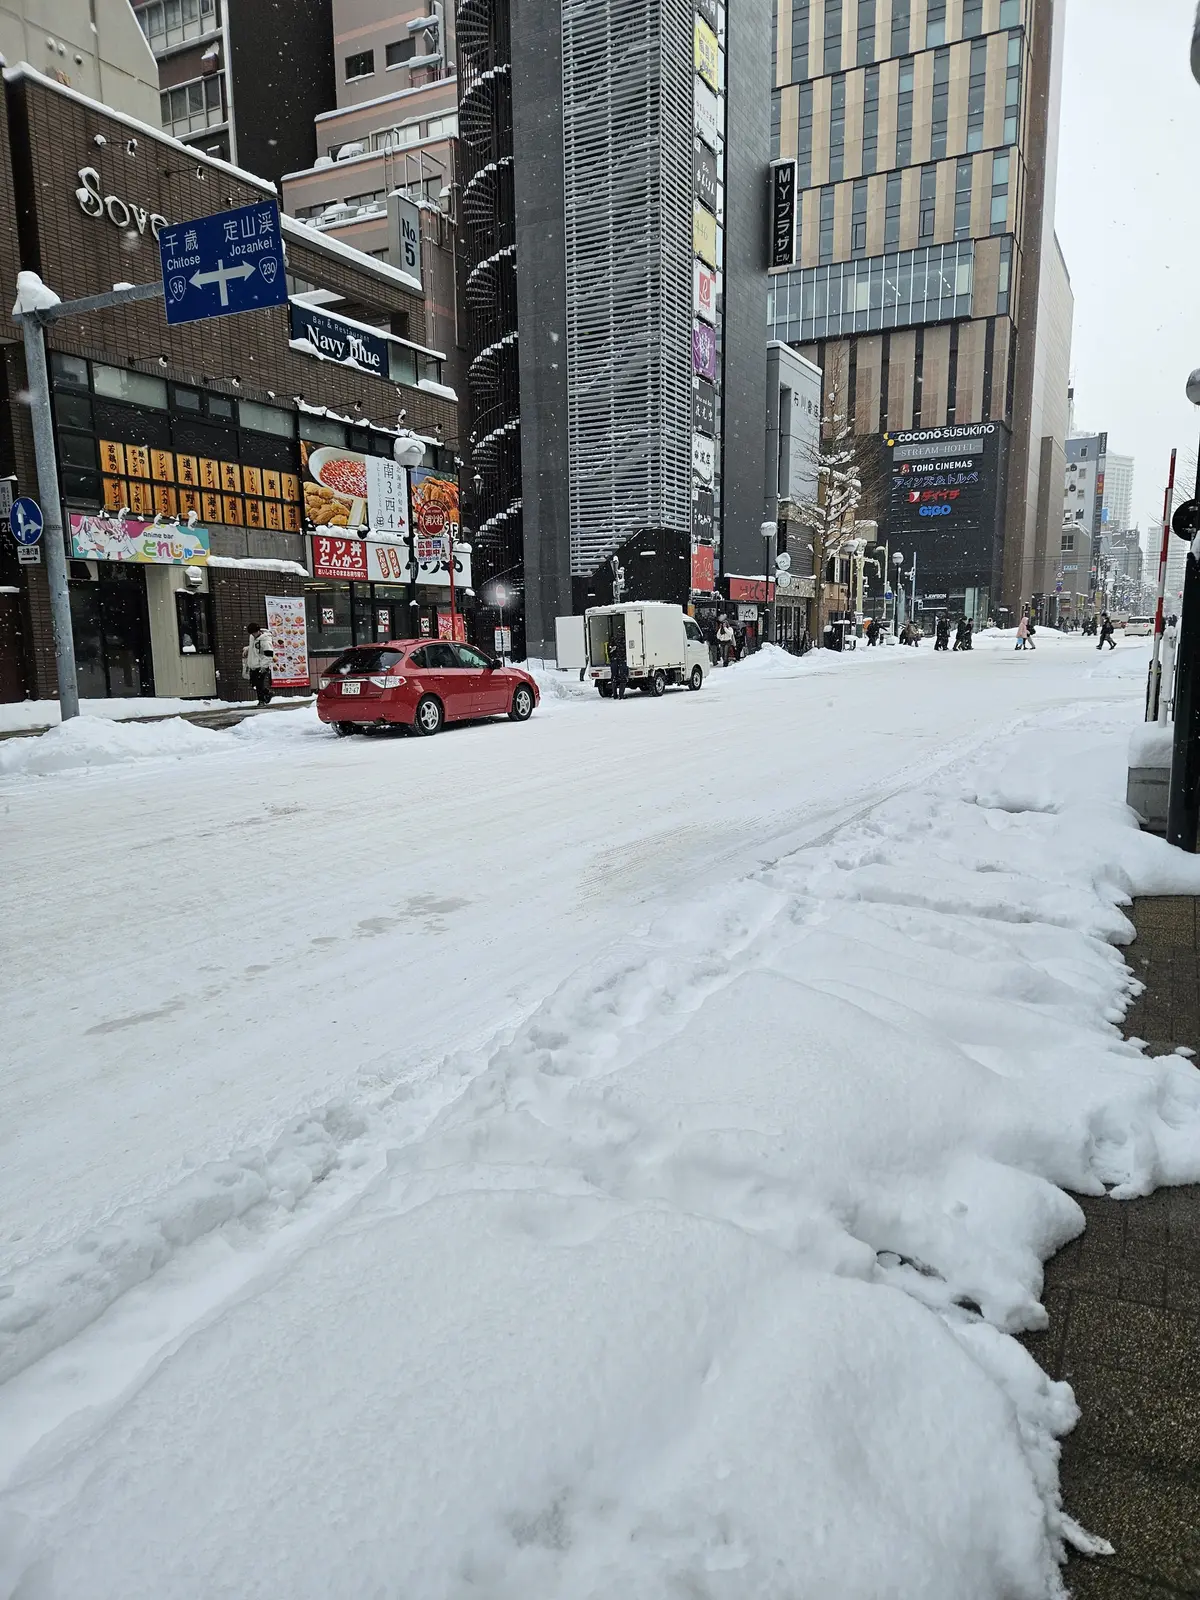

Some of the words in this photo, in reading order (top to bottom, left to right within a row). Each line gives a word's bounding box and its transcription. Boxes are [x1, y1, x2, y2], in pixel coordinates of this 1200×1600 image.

[75, 167, 163, 241] Sove
[777, 168, 791, 262] MYプラザビル
[223, 211, 274, 243] 定山渓
[401, 218, 417, 243] No.
[165, 230, 199, 255] 千歳
[230, 236, 273, 257] Jozankei
[167, 255, 200, 271] Chitose
[405, 243, 415, 267] 5
[262, 262, 275, 275] 230
[173, 281, 183, 294] 36
[312, 315, 325, 325] Bar
[334, 324, 370, 343] Restaurant
[306, 324, 345, 357] Navy
[900, 446, 939, 457] STREAM
[944, 443, 976, 453] HOTEL
[912, 463, 934, 472] TOHO
[935, 460, 973, 470] CINEMAS
[383, 463, 395, 529] 南3西4
[143, 540, 205, 558] とれじゃー
[320, 538, 362, 556] カツ丼
[418, 540, 432, 549] 広告
[320, 553, 363, 568] とんかつ
